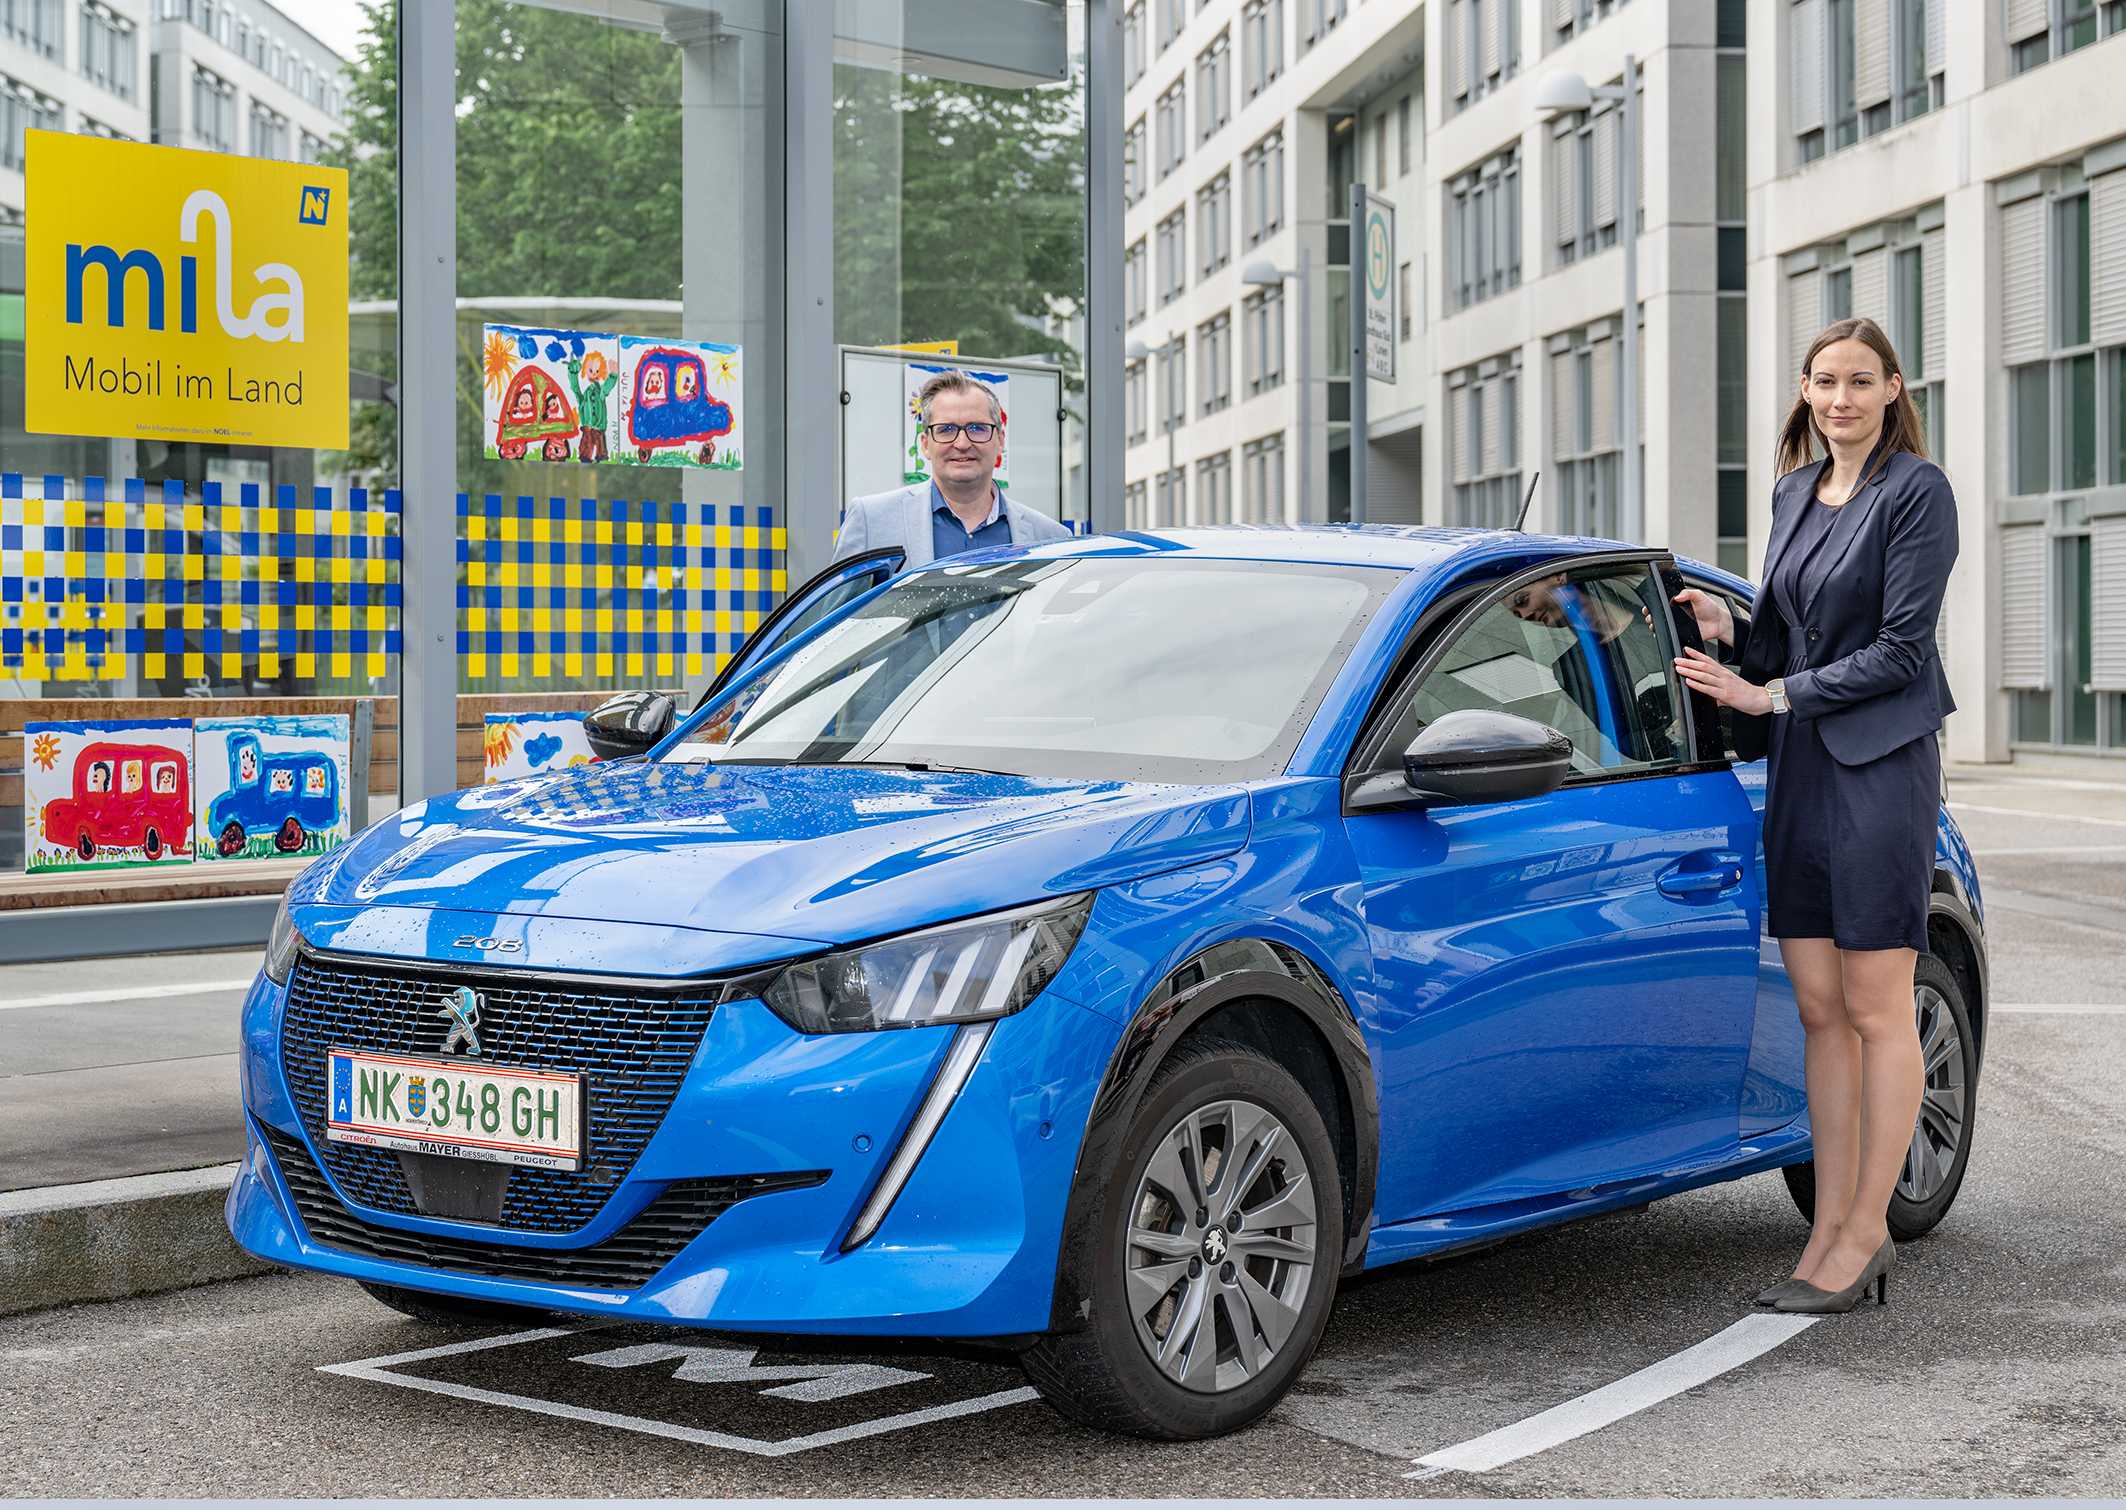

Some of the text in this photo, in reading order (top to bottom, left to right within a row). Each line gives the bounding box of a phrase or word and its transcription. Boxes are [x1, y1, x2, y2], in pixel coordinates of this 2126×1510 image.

[65, 189, 305, 343] mila
[65, 355, 303, 405] Mobil im Land
[452, 934, 524, 953] 208
[338, 1097, 348, 1114] A
[360, 1067, 560, 1141] NK 348 GH
[390, 1141, 418, 1151] Autohaus
[419, 1142, 461, 1156] MAYER
[513, 1155, 558, 1166] PEUGEOT
